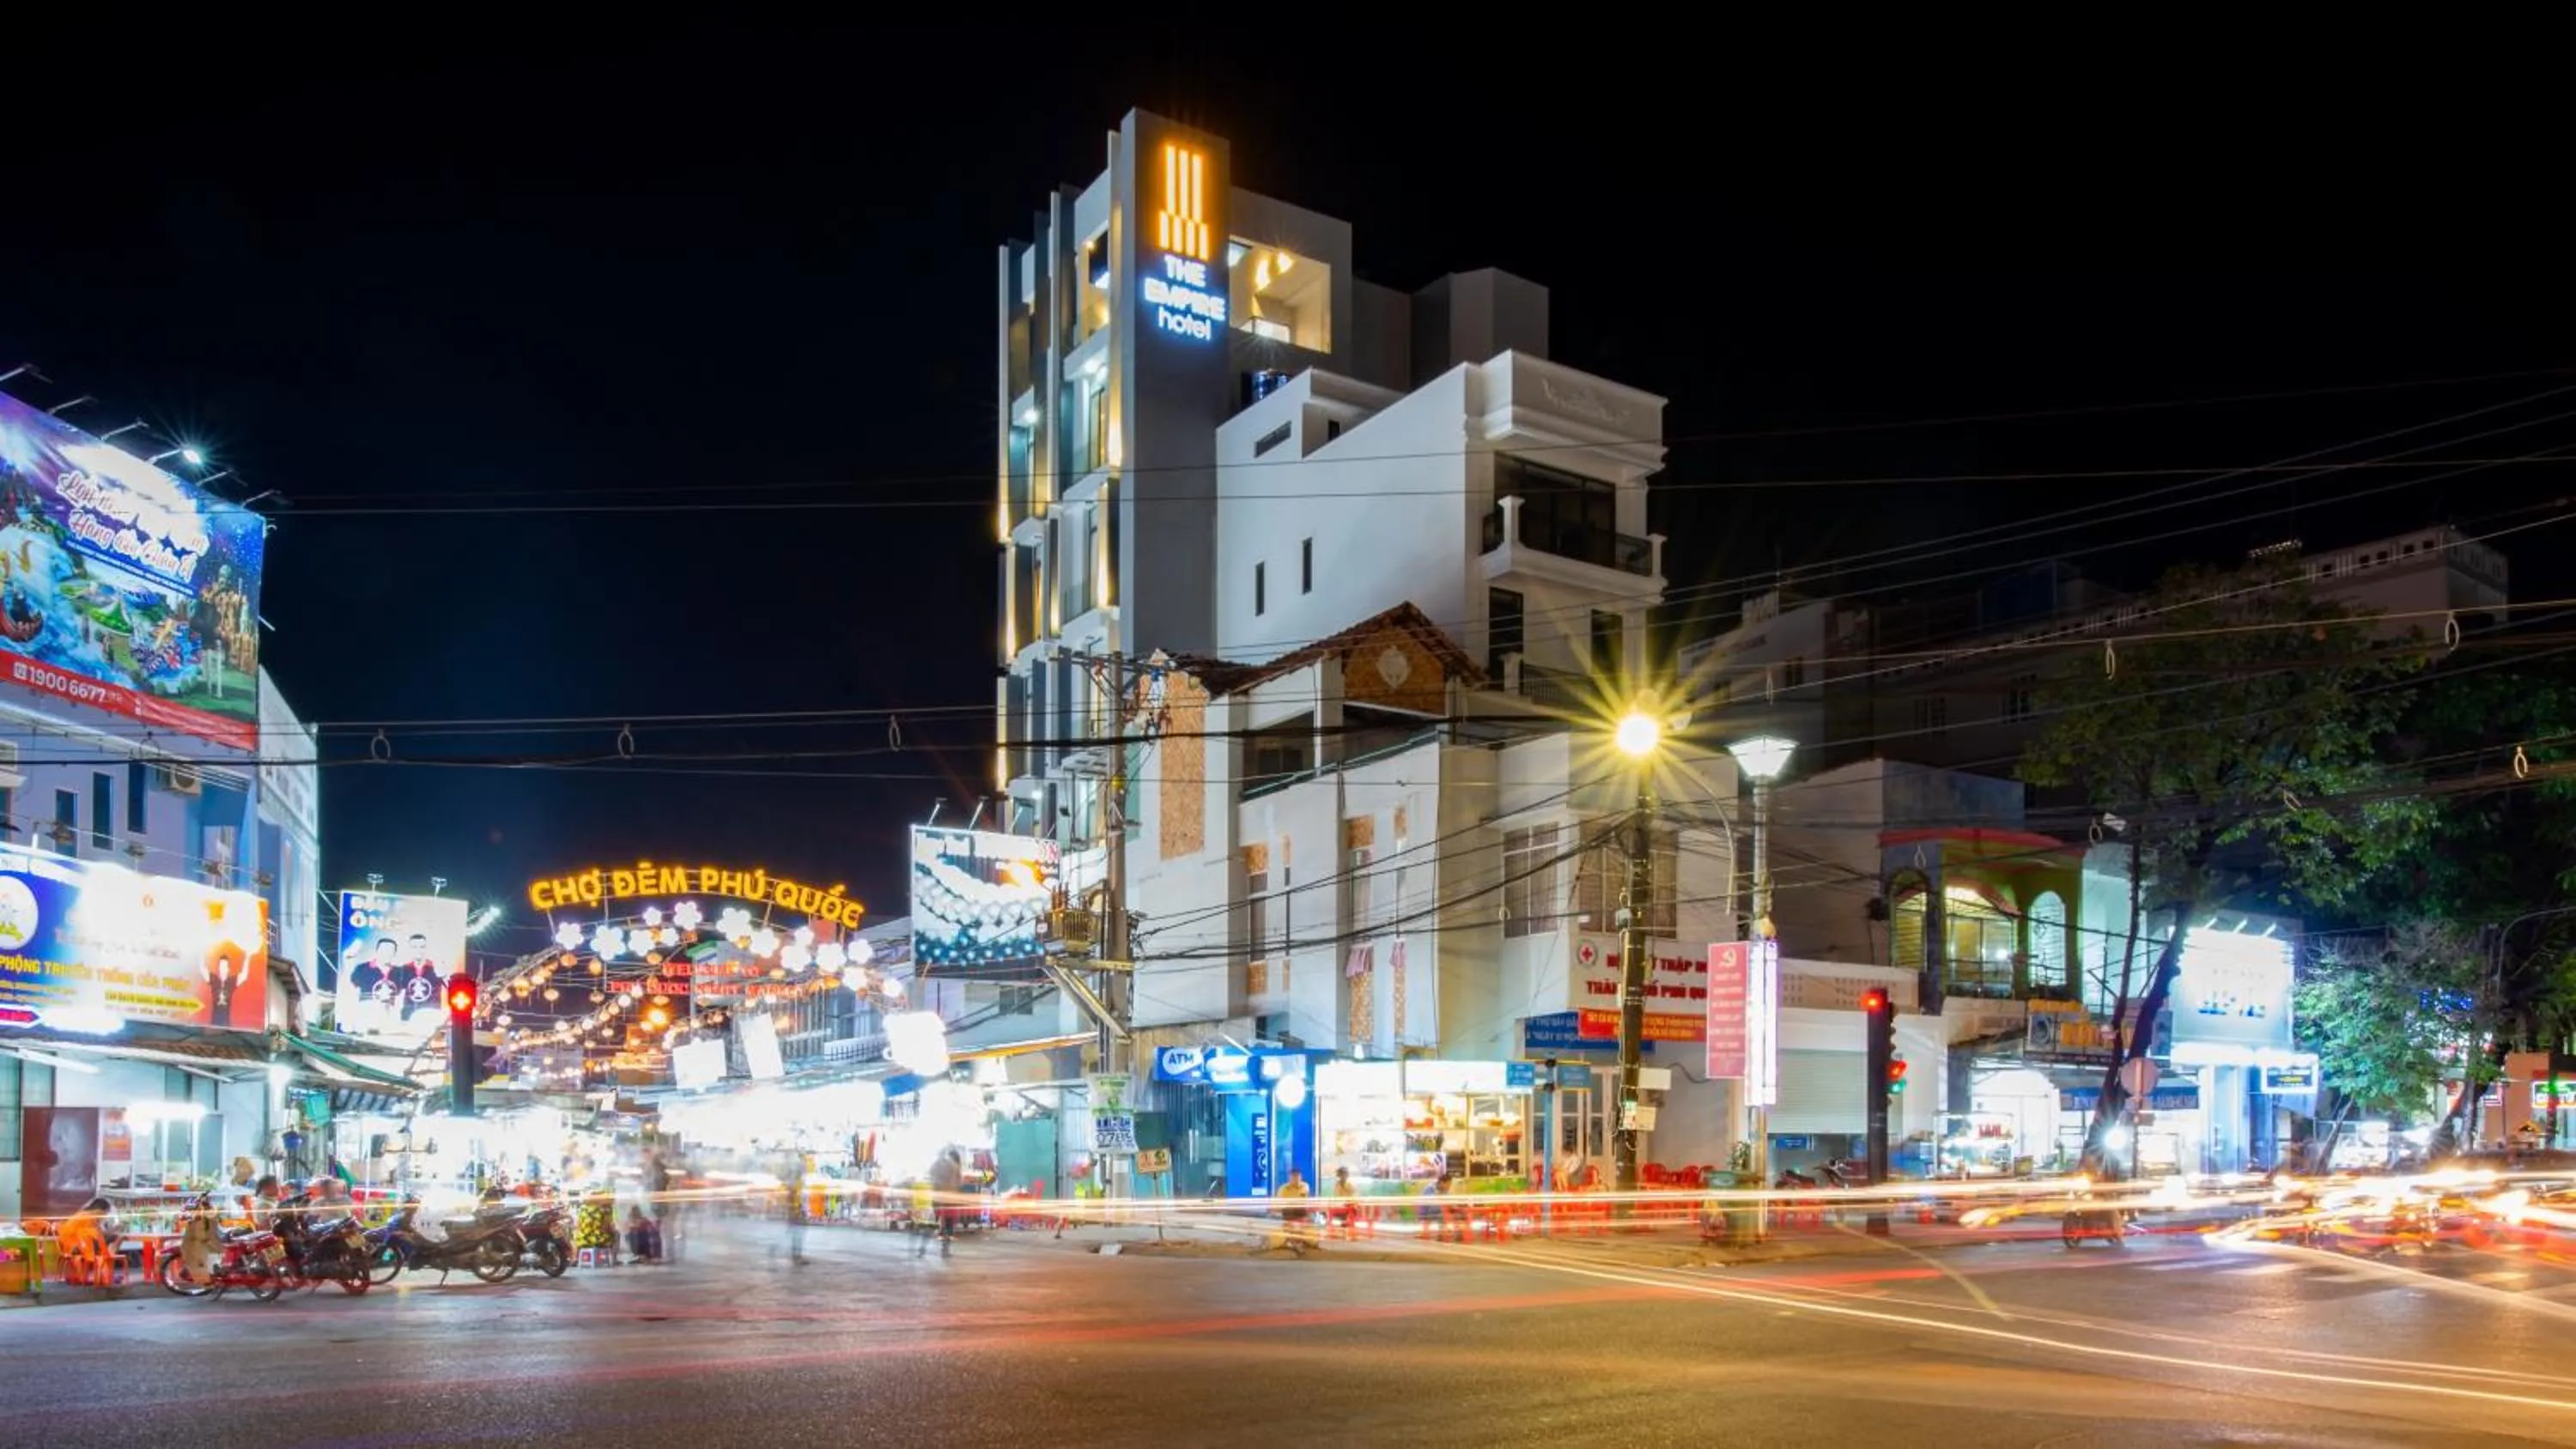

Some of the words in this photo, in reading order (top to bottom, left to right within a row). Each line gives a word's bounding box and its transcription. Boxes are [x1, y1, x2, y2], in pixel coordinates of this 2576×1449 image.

[1164, 254, 1206, 288] THE
[1145, 277, 1225, 321] EMPIRE
[1158, 306, 1212, 341] hotel
[29, 665, 67, 691] 1900
[69, 679, 106, 702] 6677
[530, 869, 601, 909] CHỢ
[612, 861, 688, 898] ĐÊM
[700, 866, 766, 900] PHÚ
[775, 881, 864, 929] QUỐC
[1168, 1053, 1194, 1065] ATM
